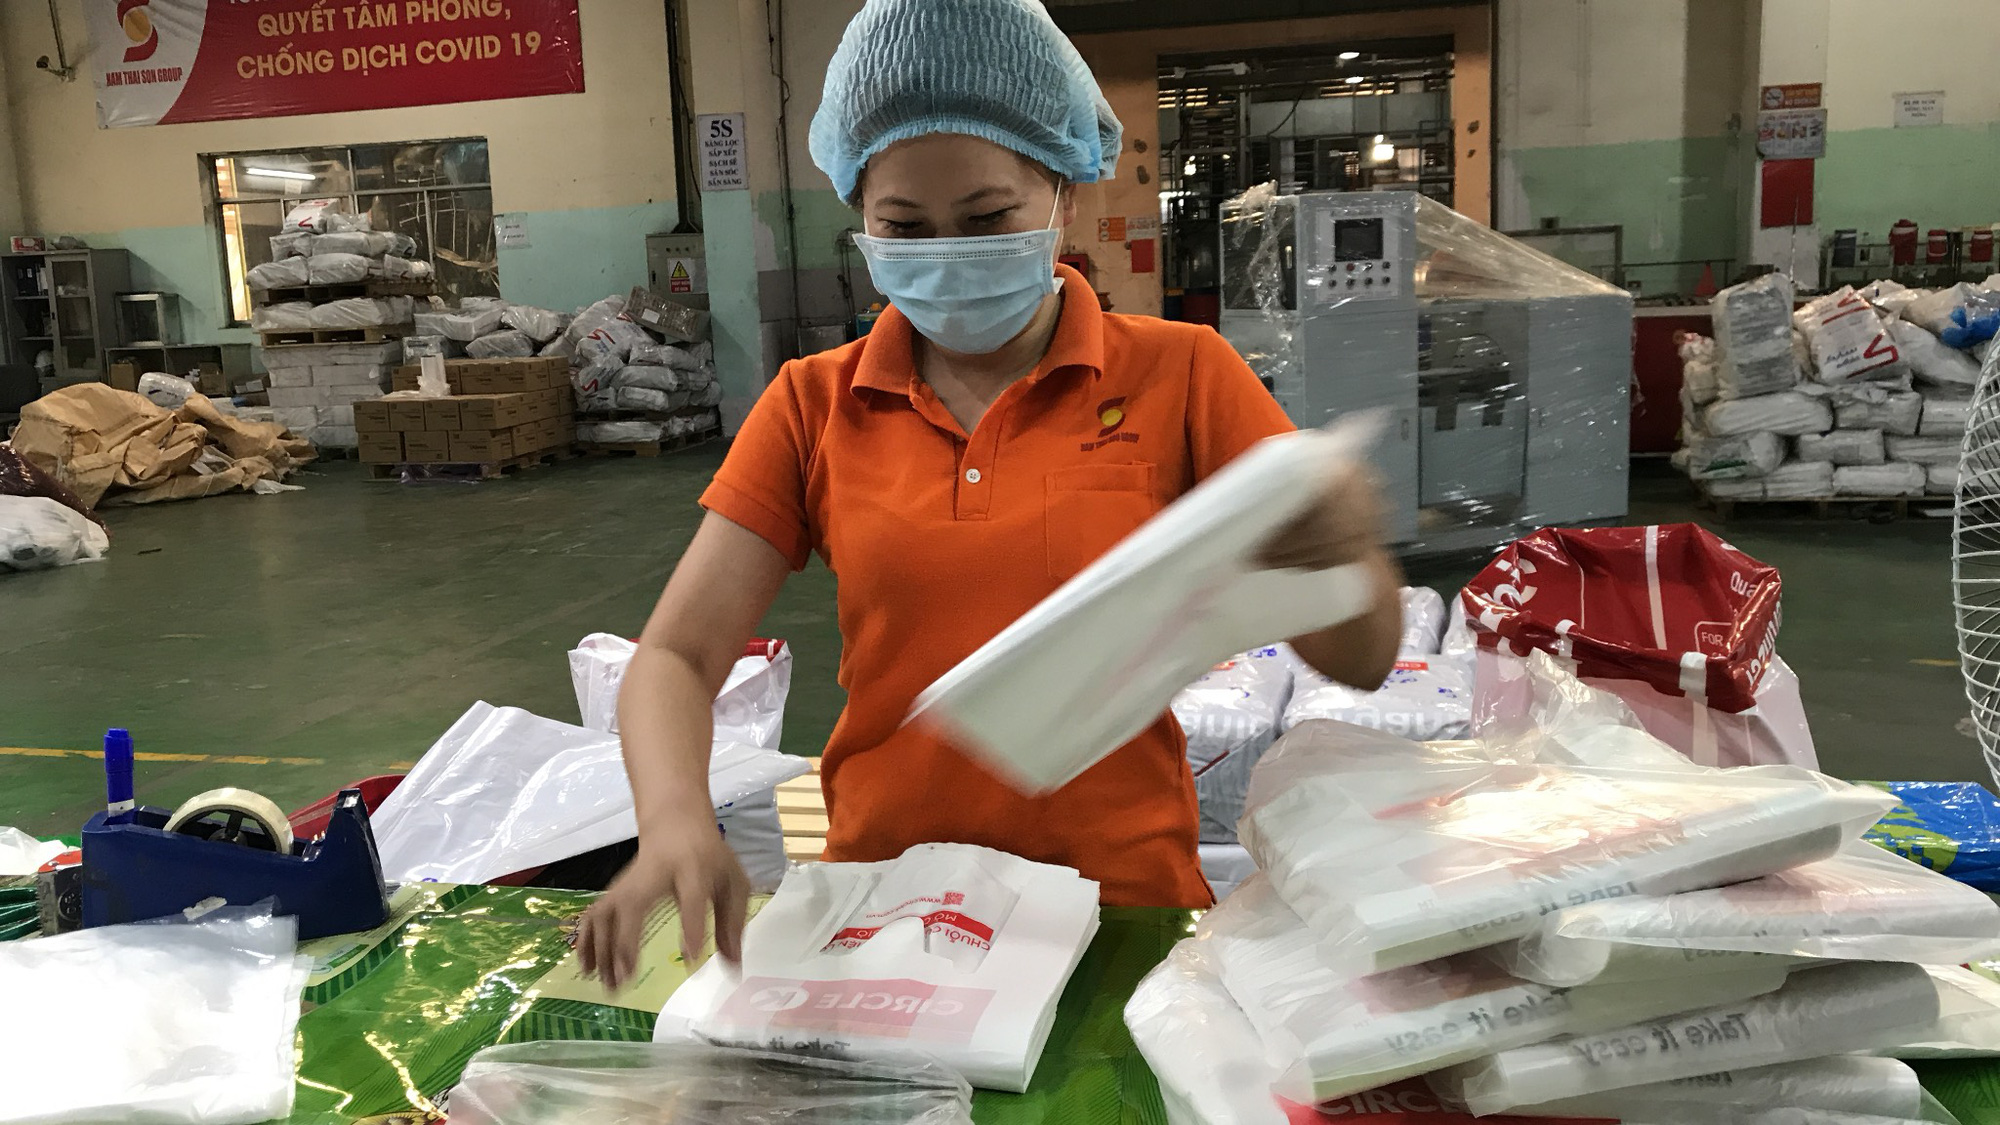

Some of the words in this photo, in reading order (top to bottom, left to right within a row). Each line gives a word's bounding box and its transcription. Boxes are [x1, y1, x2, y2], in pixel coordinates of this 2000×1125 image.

[258, 0, 336, 37] QUYẾT
[343, 0, 398, 30] TÂM
[237, 42, 335, 79] CHỐNG
[342, 43, 407, 76] DỊCH
[415, 35, 502, 64] COVID
[511, 31, 541, 56] 19
[157, 67, 183, 83] GROUP
[710, 119, 733, 138] 5S
[1701, 631, 1723, 647] FOR
